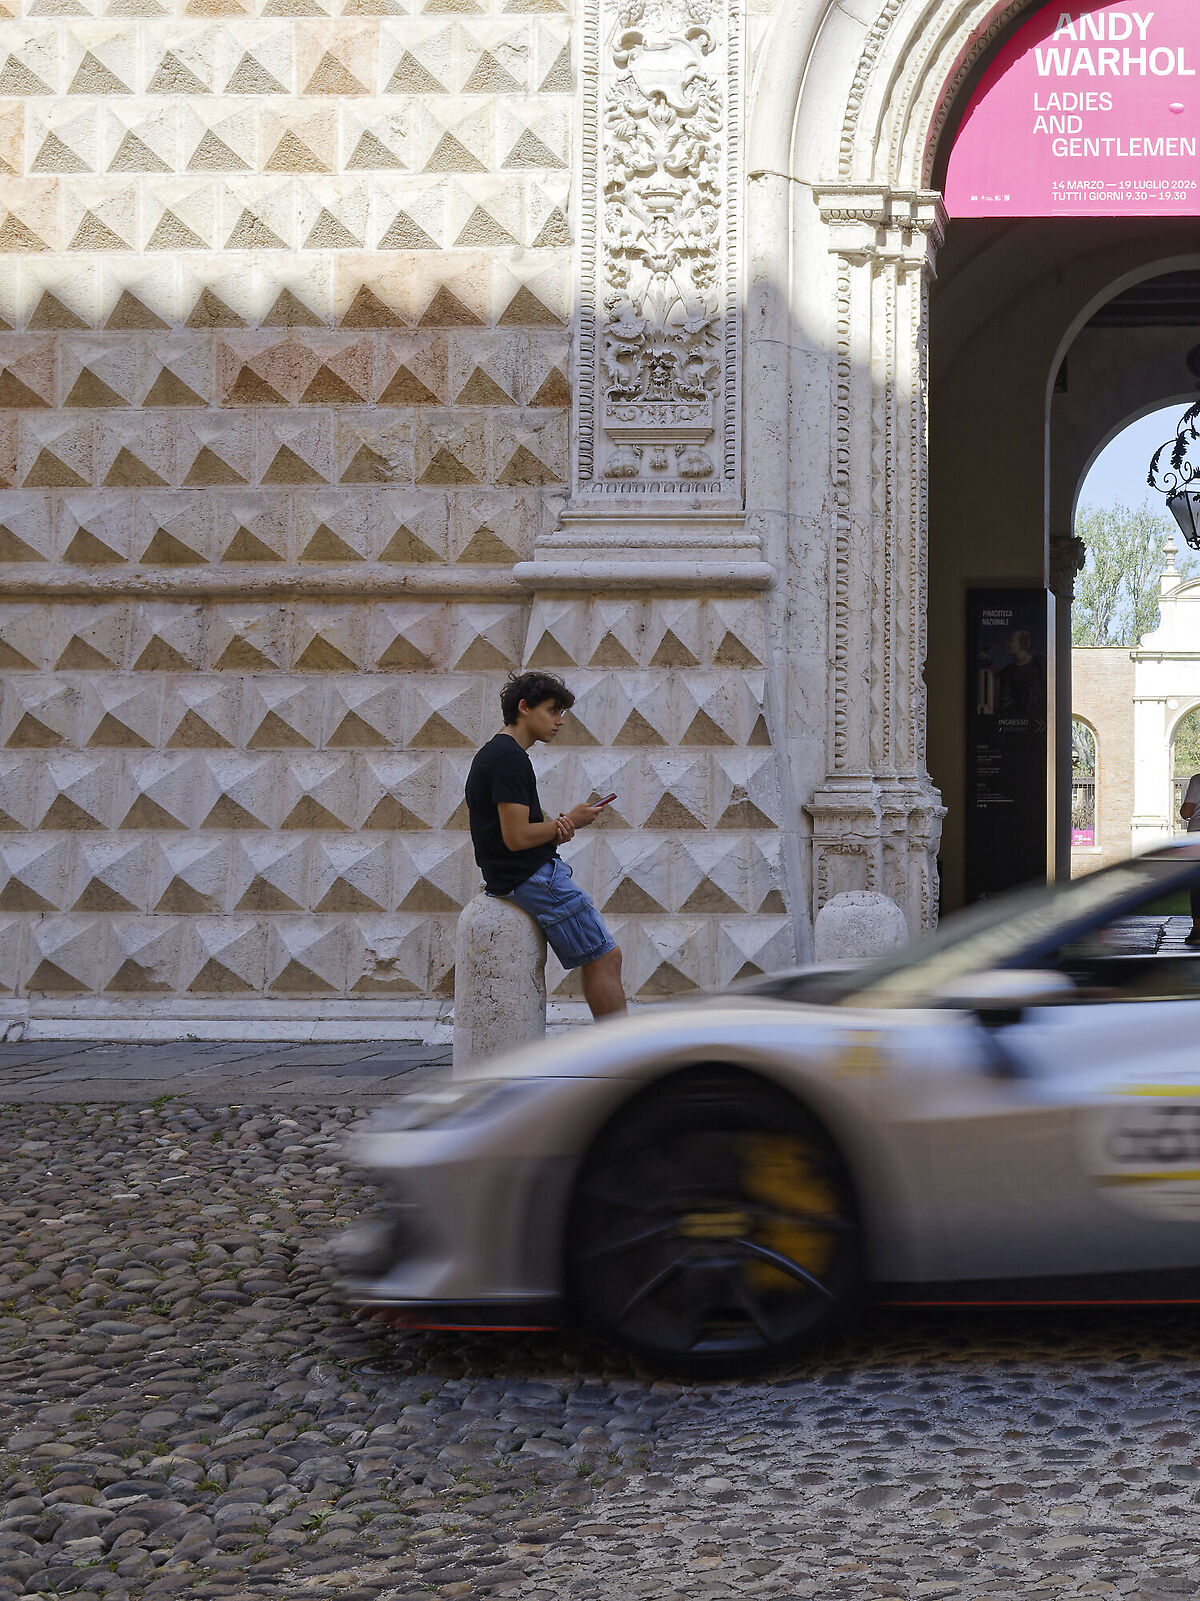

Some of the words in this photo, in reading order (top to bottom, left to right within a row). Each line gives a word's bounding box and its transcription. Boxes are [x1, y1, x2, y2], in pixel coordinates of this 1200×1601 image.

[1052, 12, 1155, 41] ANDY
[1034, 46, 1196, 76] WARHOL
[1033, 91, 1113, 111] LADIES
[1032, 115, 1083, 134] AND
[1051, 137, 1196, 157] GENTLEMEN
[1052, 180, 1065, 190] 14
[1067, 180, 1104, 190] MARZO
[1119, 180, 1132, 190] 19
[1133, 180, 1169, 190] LUGLIO
[1171, 180, 1197, 190] 2026
[1052, 191, 1081, 201] TUTTI
[1088, 191, 1124, 201] GIORNI
[1126, 191, 1148, 201] 9.30
[1159, 191, 1187, 201] 19.30
